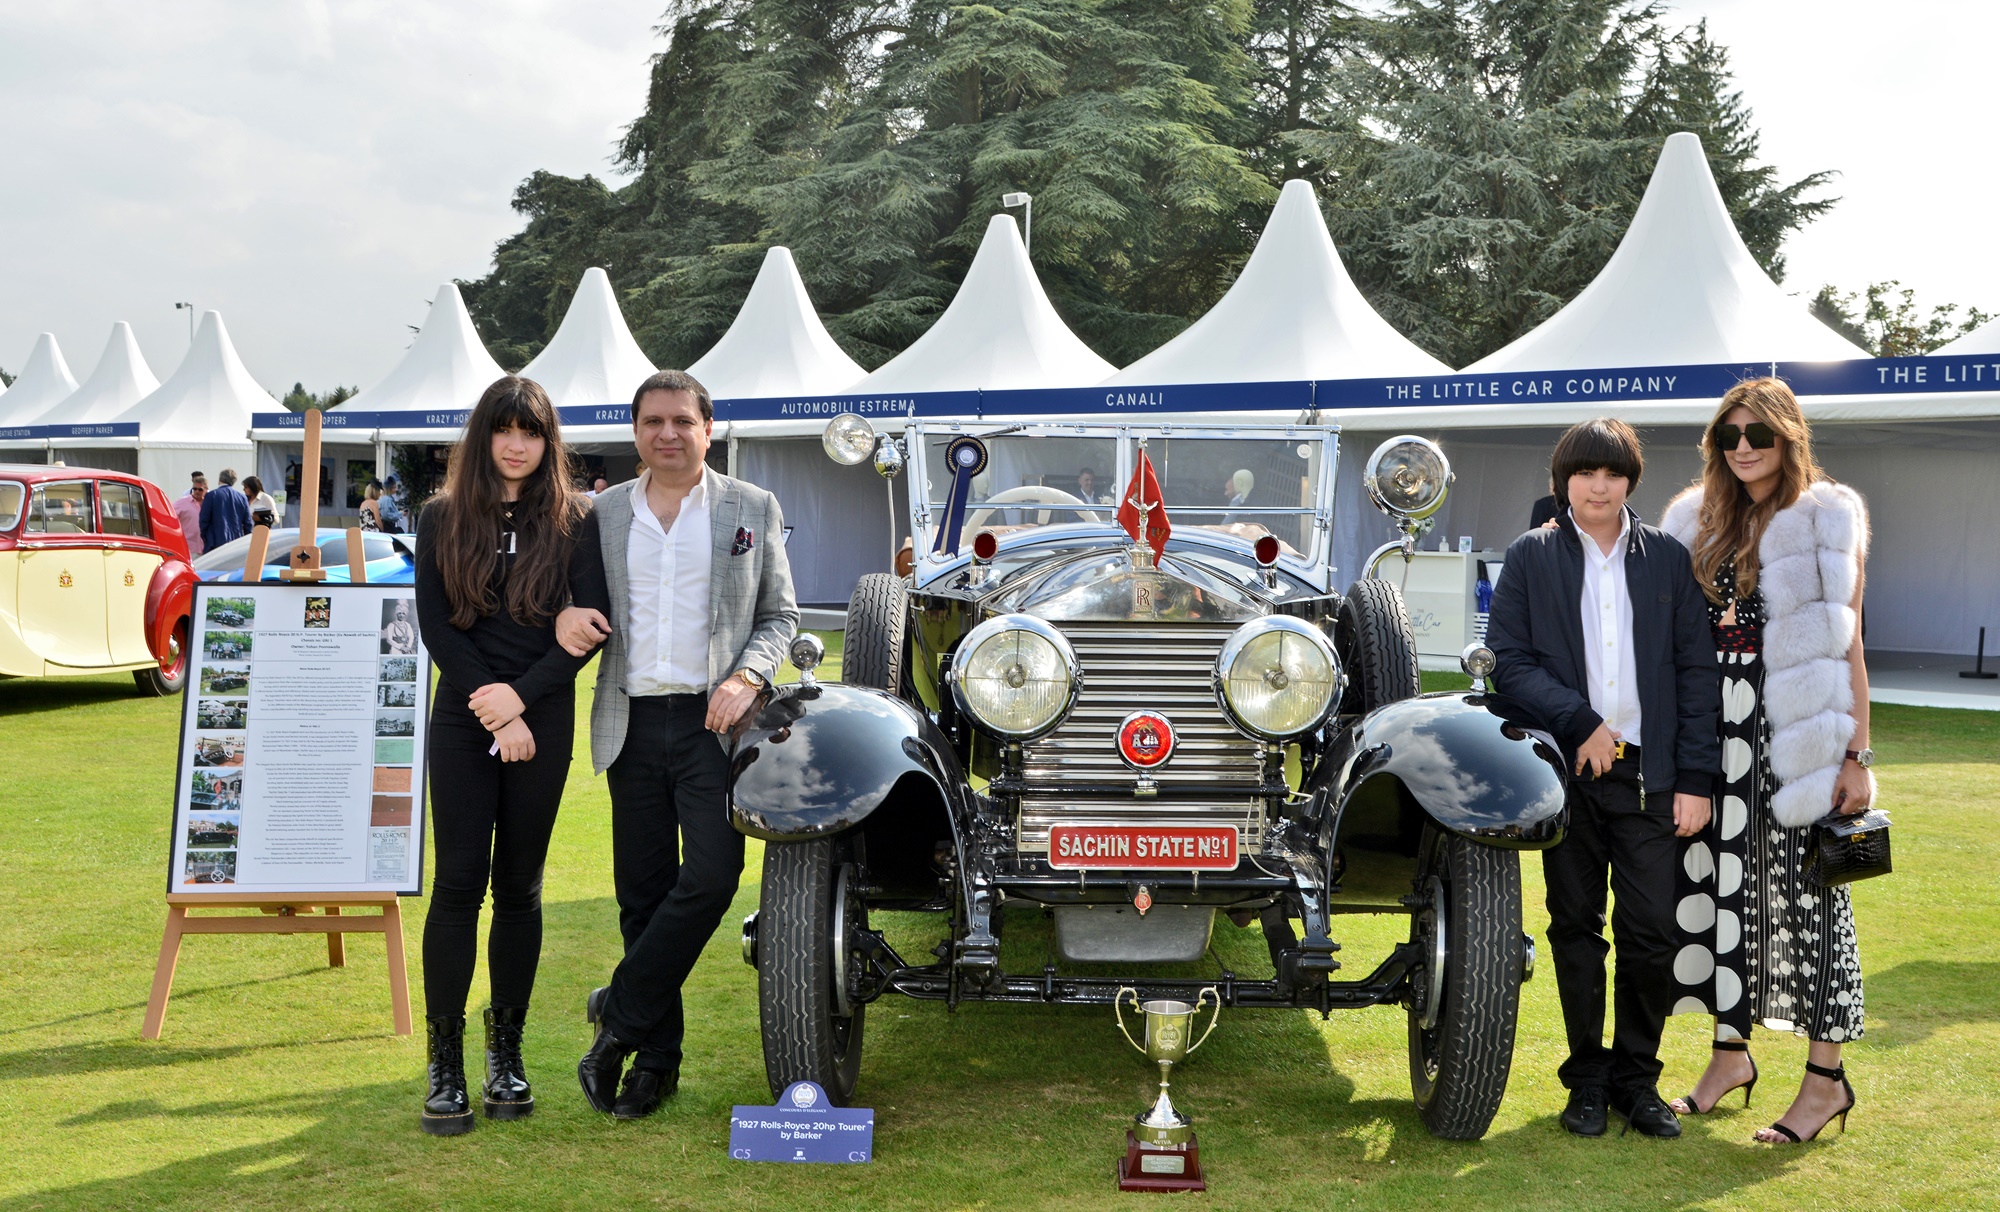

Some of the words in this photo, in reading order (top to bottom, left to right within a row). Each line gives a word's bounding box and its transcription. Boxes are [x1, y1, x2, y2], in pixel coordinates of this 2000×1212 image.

[1877, 366, 1927, 384] THE
[1385, 384, 1421, 399] THE
[1433, 382, 1500, 398] LITTLE
[1512, 379, 1553, 396] CAR
[1566, 376, 1677, 395] COMPANY
[1105, 391, 1163, 407] CANALI
[781, 401, 853, 414] AUTOMOBILI
[860, 399, 916, 413] ESTREMA
[278, 416, 303, 426] SLOANE
[321, 416, 347, 425] OPTERS
[426, 414, 451, 424] KRAZY
[595, 410, 626, 420] KRAZY
[95, 426, 114, 434] PARKER
[1058, 834, 1130, 858] SACHIN
[1135, 834, 1195, 858] STATE
[738, 1120, 759, 1129] 1927
[760, 1120, 811, 1132] Rolls-Royce
[812, 1121, 836, 1132] 20hp
[838, 1122, 867, 1132] Tourer
[780, 1131, 791, 1141] by
[793, 1131, 823, 1140] Barker
[733, 1148, 751, 1160] C5
[848, 1151, 867, 1162] C5
